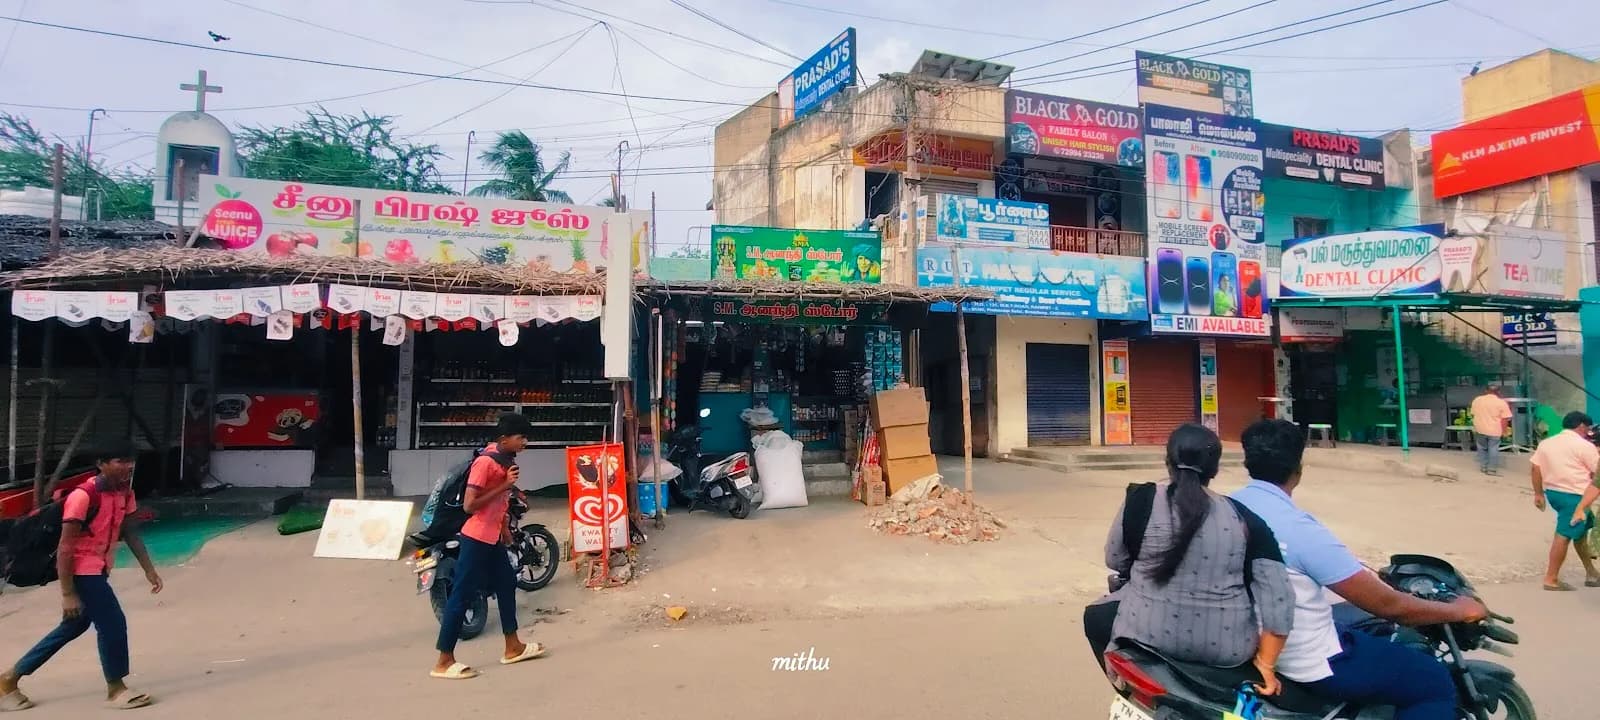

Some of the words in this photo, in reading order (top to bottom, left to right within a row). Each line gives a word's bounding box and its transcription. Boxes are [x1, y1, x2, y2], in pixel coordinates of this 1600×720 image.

[795, 41, 849, 96] PRASAD'S
[1140, 58, 1174, 75] BLACK
[1192, 67, 1221, 82] GOLD
[1015, 95, 1071, 121] BLACK
[1095, 108, 1138, 129] GOLD
[1048, 125, 1079, 137] FAMILY
[1081, 130, 1108, 141] SALON
[1292, 128, 1361, 154] PRASAD'S
[1462, 148, 1485, 161] KLM
[1530, 120, 1584, 144] FINVEST
[1042, 136, 1067, 147] UNISEX
[1069, 140, 1087, 150] HAIR
[1154, 138, 1176, 149] Before
[1266, 147, 1313, 166] Multispeciality
[1316, 153, 1353, 170] DENTAL
[1353, 158, 1384, 174] CLINIC
[214, 208, 253, 220] Seenu
[375, 195, 480, 227] பிரஷ்
[491, 208, 590, 230] ஜூஸ்
[209, 223, 257, 238] JUICE
[1158, 221, 1182, 231] MOBILE
[1184, 224, 1207, 232] SCREEN
[1161, 229, 1207, 238] REPLACEMENT
[1311, 240, 1329, 264] பல்
[1331, 236, 1432, 268] மருத்துவமனை
[926, 259, 936, 271] R
[963, 262, 971, 273] T
[1503, 262, 1529, 282] TEA
[1533, 266, 1563, 285] TIME
[1304, 270, 1361, 287] DENTAL
[1367, 266, 1426, 285] CLINIC
[1014, 287, 1049, 295] REGULAR
[714, 301, 737, 315] S.M.
[740, 302, 799, 320] ஆனந்தி
[804, 302, 858, 320] ஸ்டோர்
[1177, 317, 1198, 331] EMI
[1202, 319, 1265, 334] AVAILABLE
[1121, 702, 1134, 718] TN
